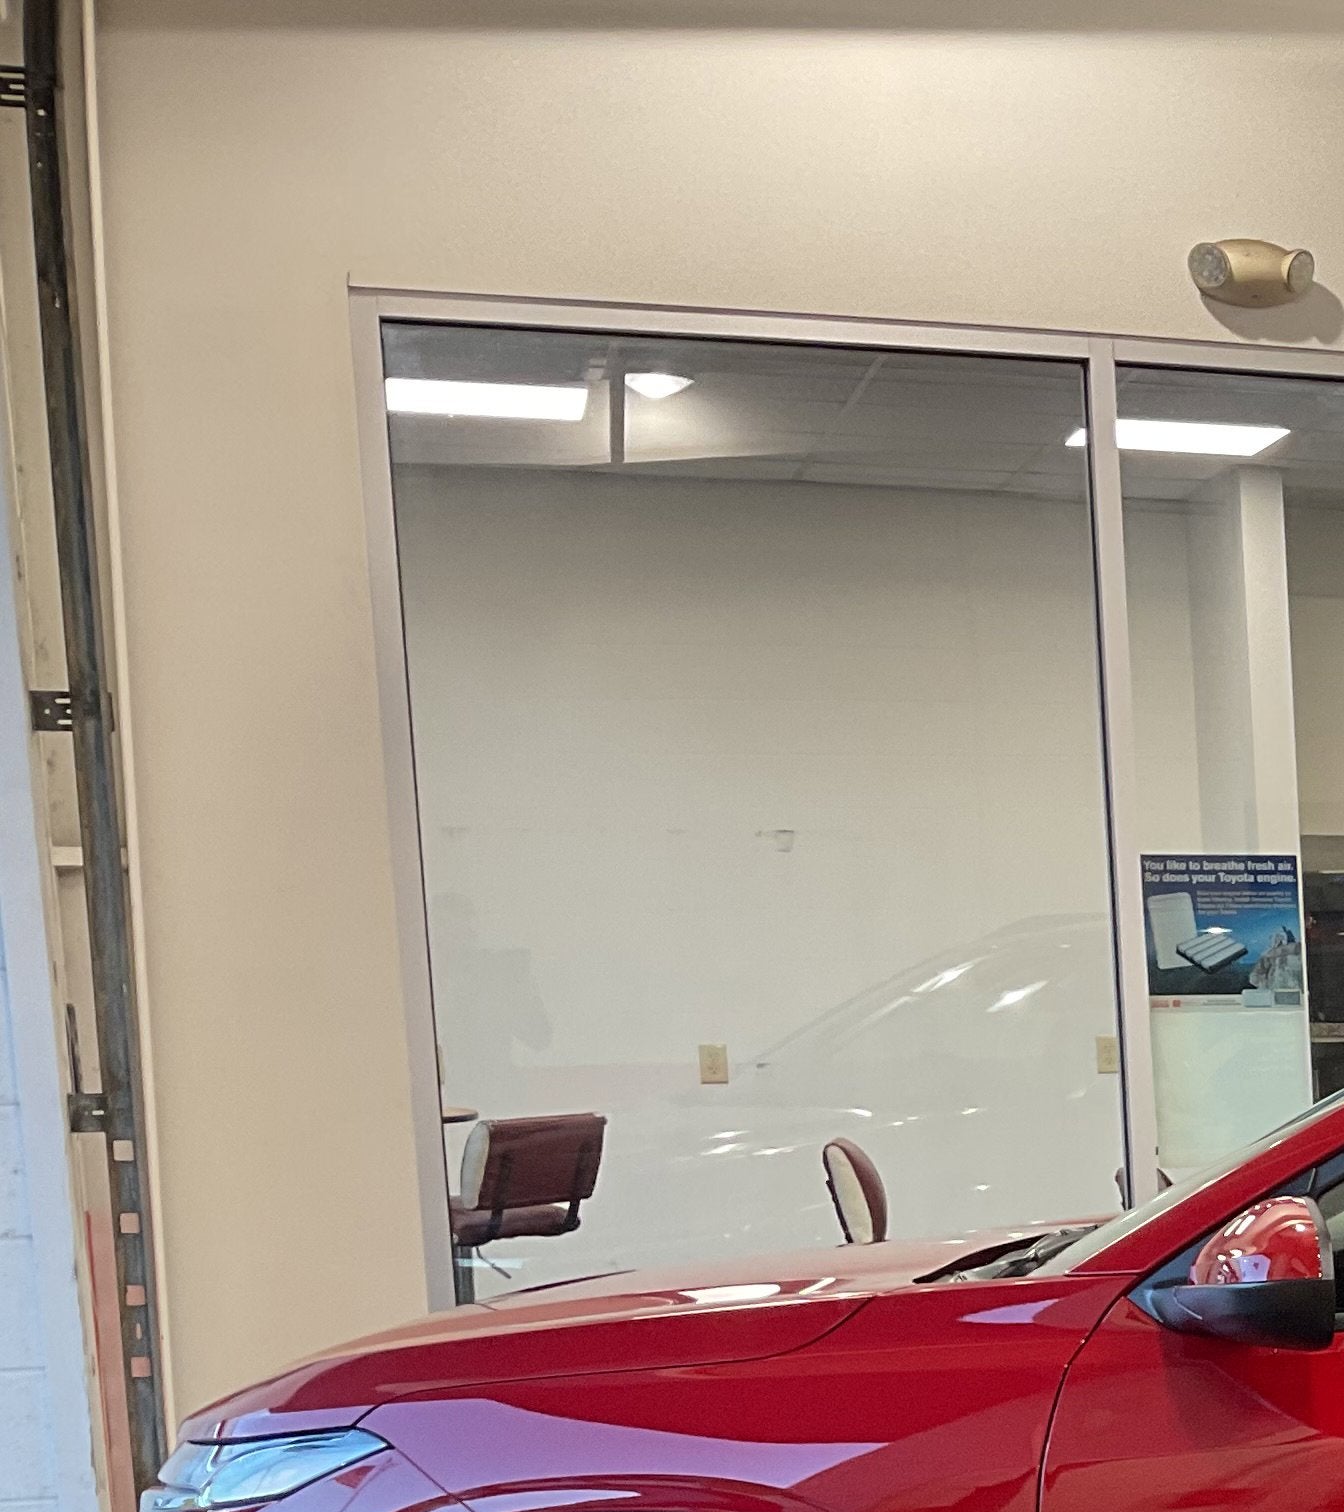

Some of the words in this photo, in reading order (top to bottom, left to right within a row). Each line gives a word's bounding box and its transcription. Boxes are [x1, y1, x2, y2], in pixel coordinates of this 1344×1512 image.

[1144, 861, 1164, 870] You
[1166, 860, 1187, 870] like
[1188, 861, 1201, 870] to
[1202, 861, 1245, 870] breathe
[1247, 861, 1275, 870] fresh
[1277, 861, 1294, 870] air.
[1144, 872, 1160, 882] So
[1161, 873, 1190, 882] does
[1191, 874, 1216, 884] your
[1217, 872, 1255, 884] Toyota
[1256, 874, 1297, 884] engine.
